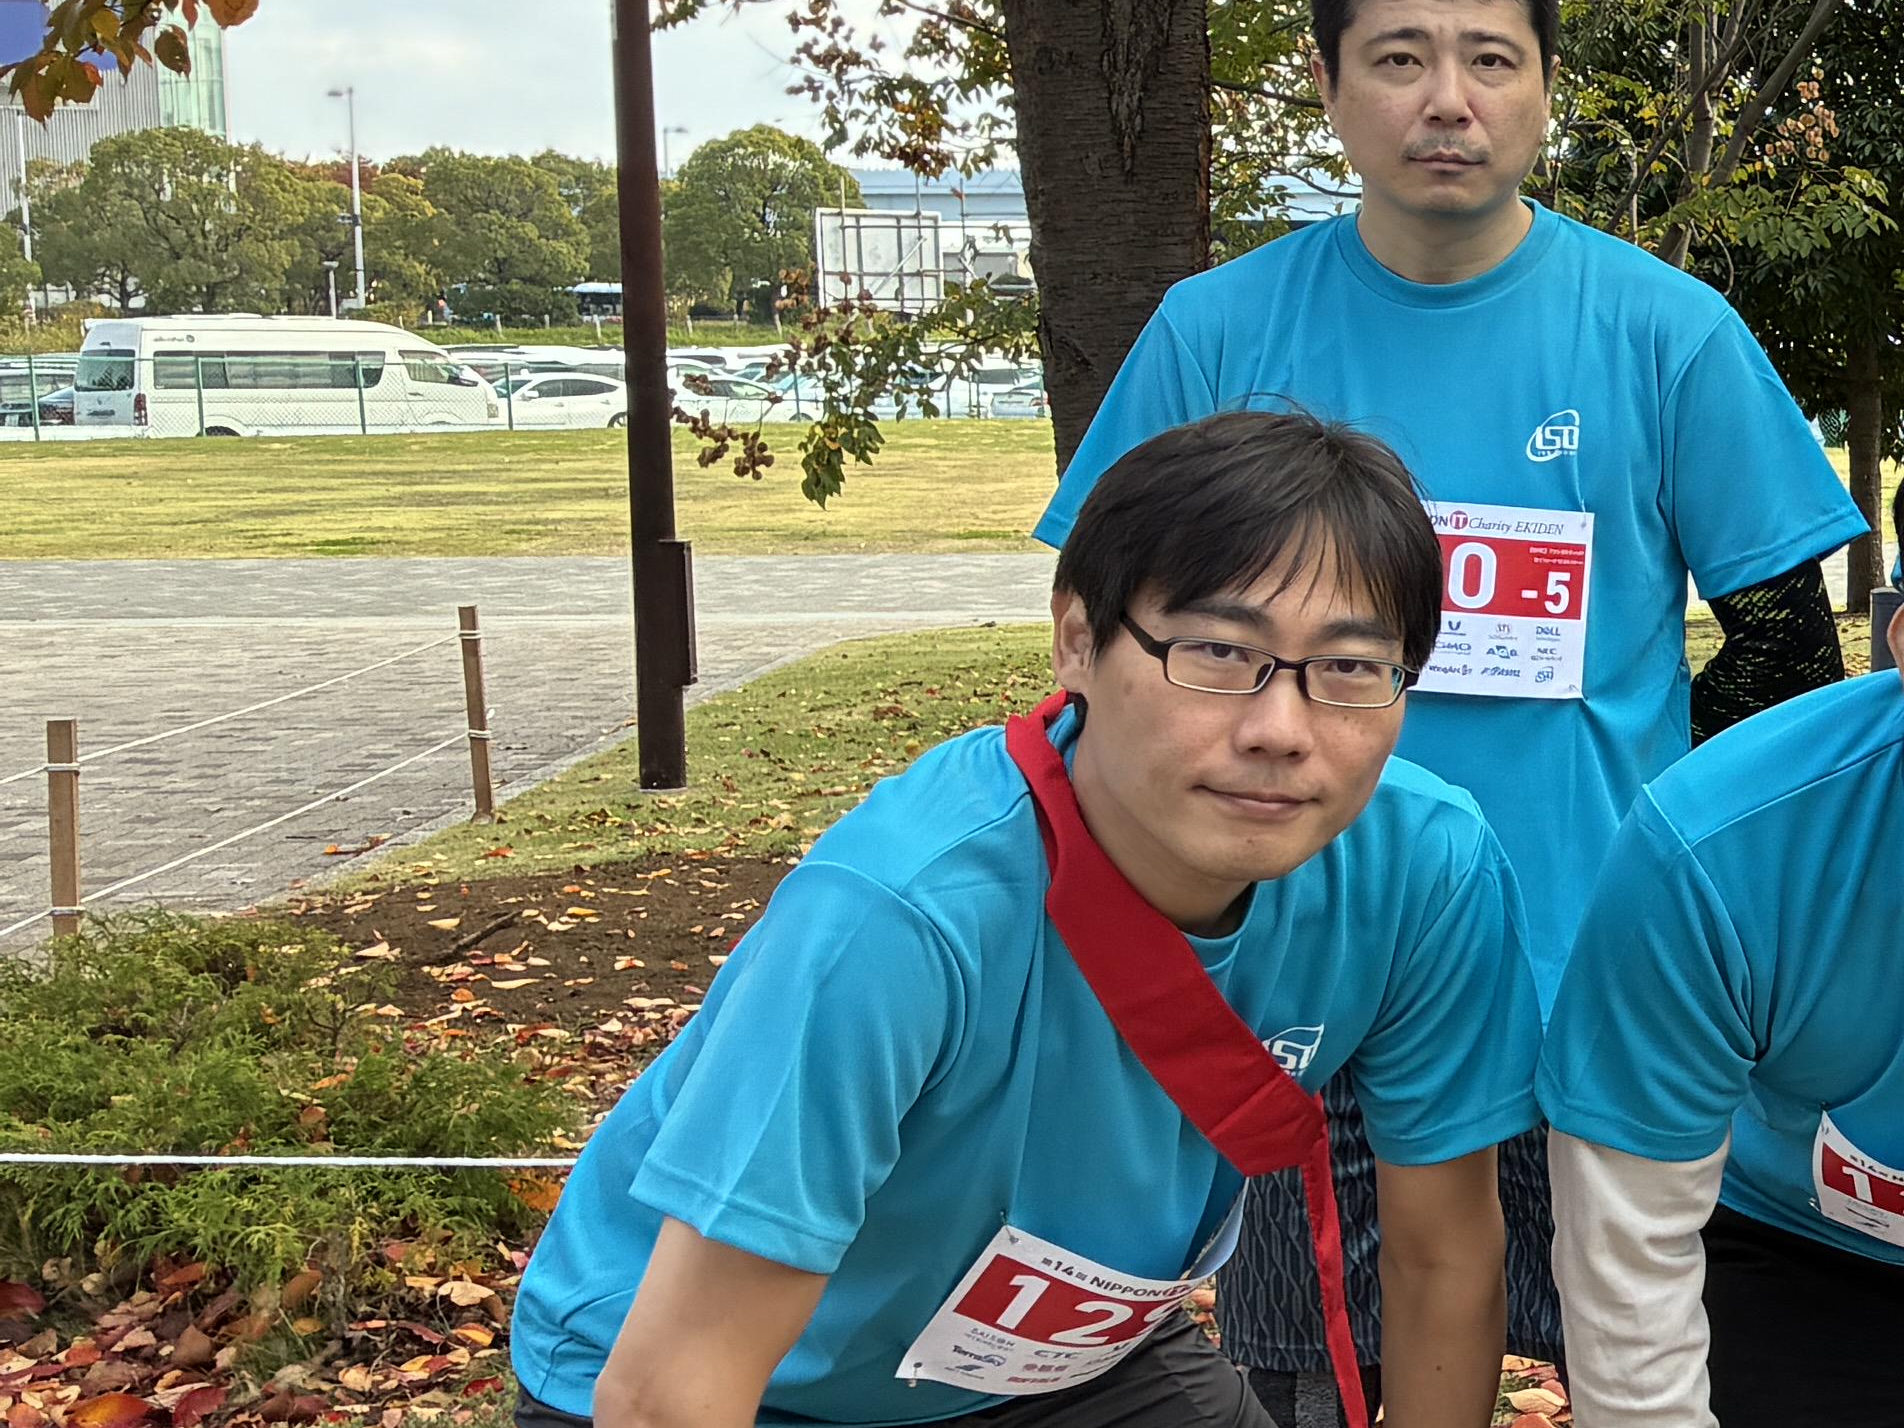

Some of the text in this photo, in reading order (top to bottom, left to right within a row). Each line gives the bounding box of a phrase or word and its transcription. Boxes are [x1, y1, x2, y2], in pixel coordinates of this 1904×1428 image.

[1469, 518, 1512, 533] Charity
[1514, 521, 1564, 535] EKIDEN
[1090, 1276, 1165, 1297] NIPPON
